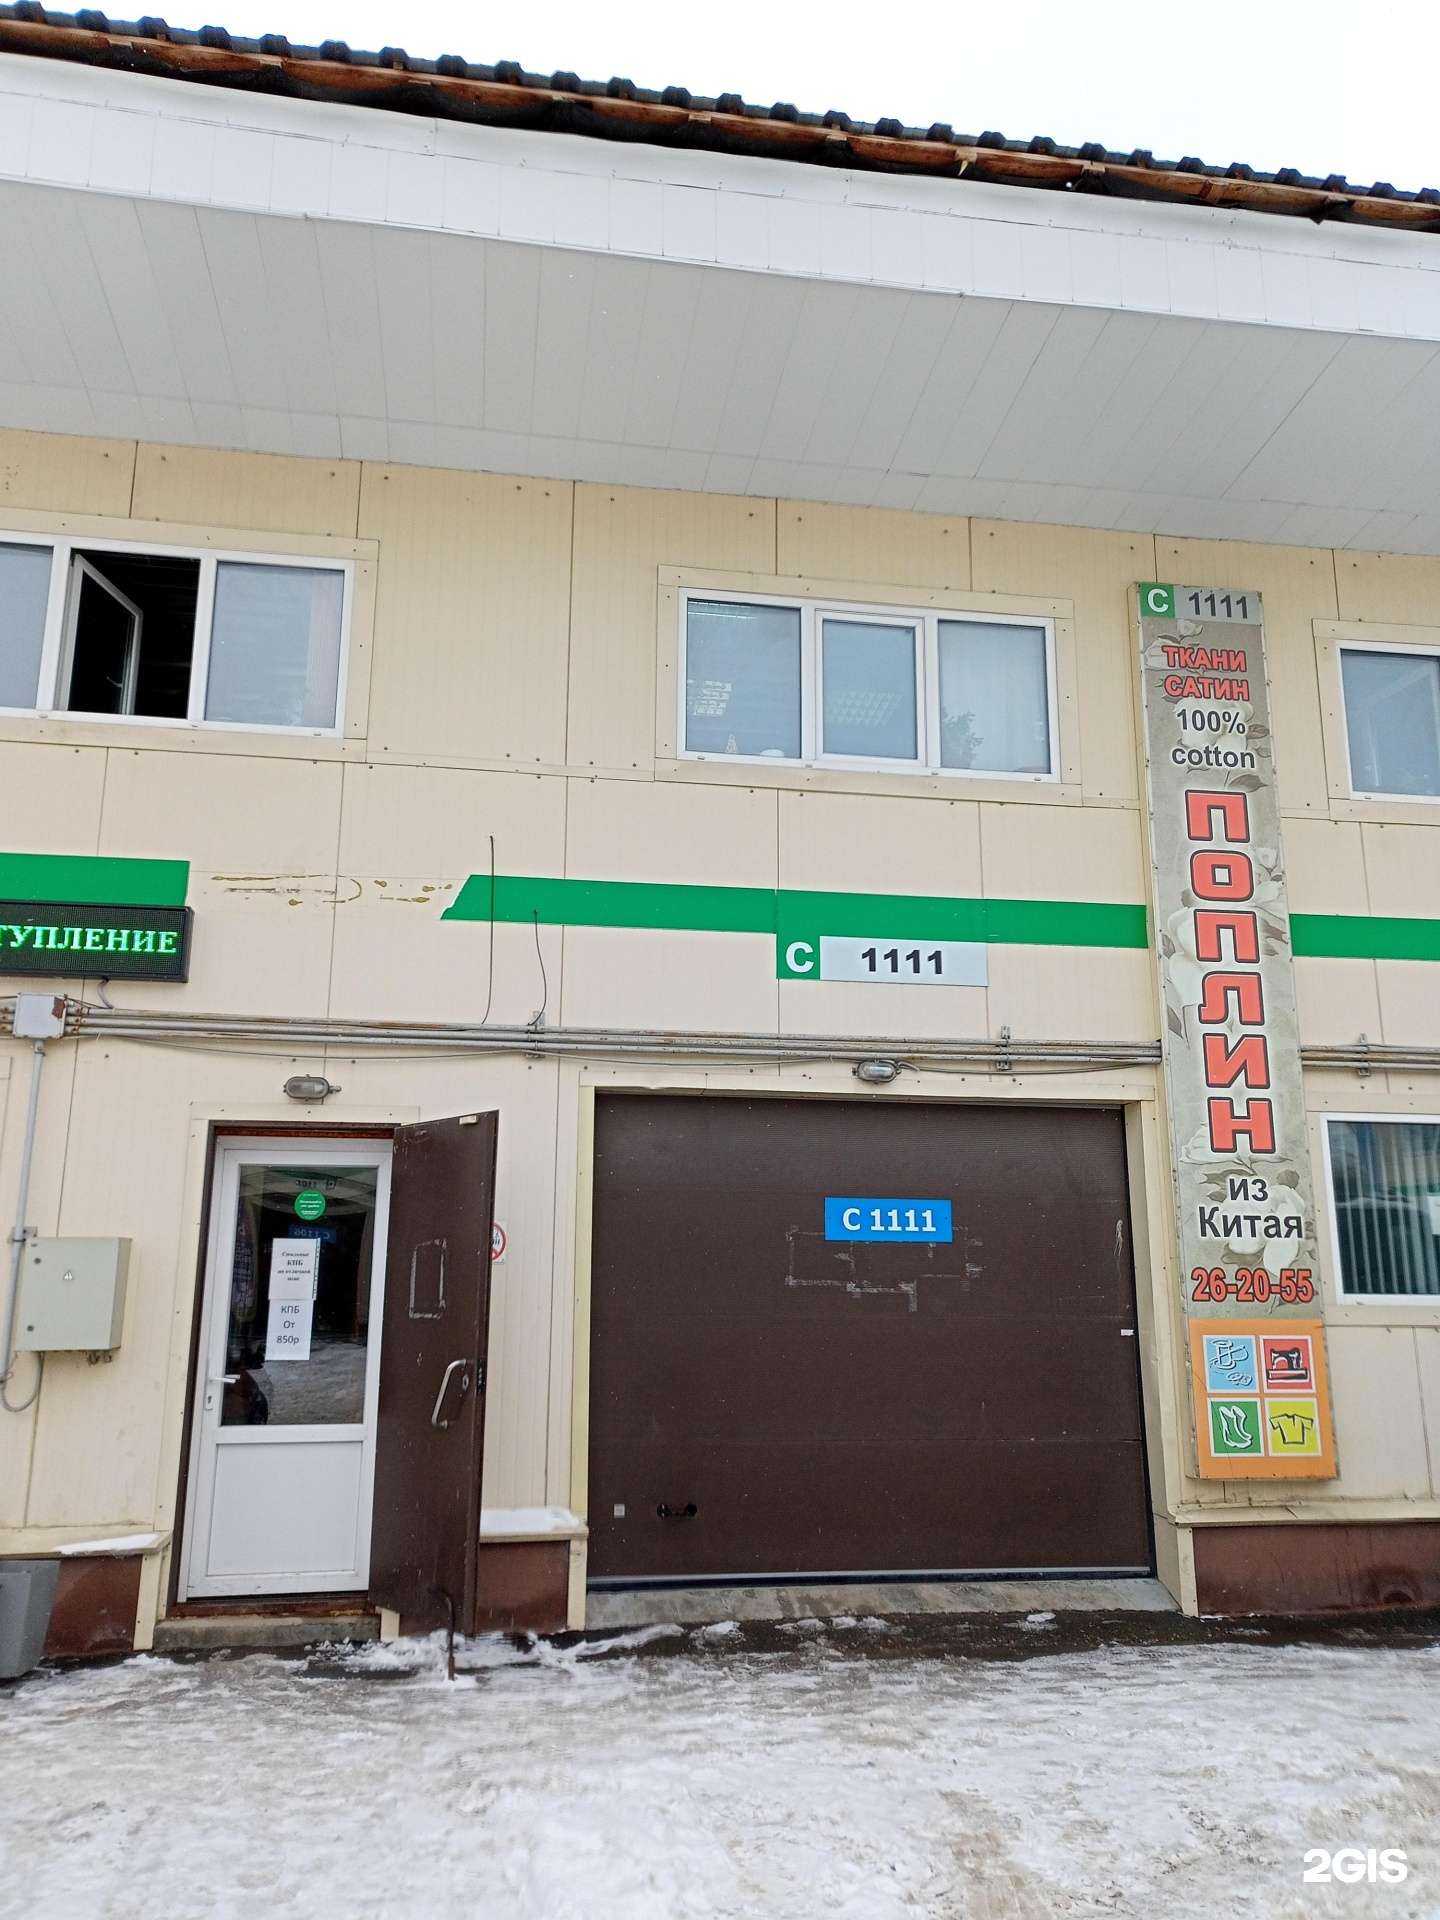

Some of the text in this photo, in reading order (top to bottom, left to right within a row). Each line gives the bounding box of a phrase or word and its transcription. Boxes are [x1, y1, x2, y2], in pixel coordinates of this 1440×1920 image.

[1147, 588, 1248, 619] С 1111
[1162, 645, 1247, 672] ТКАНИ
[1164, 675, 1250, 701] САТИН
[1176, 709, 1246, 734] 100%
[1172, 745, 1255, 768] cotton
[785, 942, 943, 975] С 1111
[1185, 789, 1276, 1153] ПОПЛИН
[1229, 1178, 1269, 1201] из
[842, 1208, 936, 1232] С 1111
[1198, 1206, 1303, 1238] Китая
[1191, 1267, 1314, 1303] 26-20-55
[281, 1305, 300, 1314] КПБ
[283, 1320, 295, 1329] От
[276, 1335, 300, 1345] 850р
